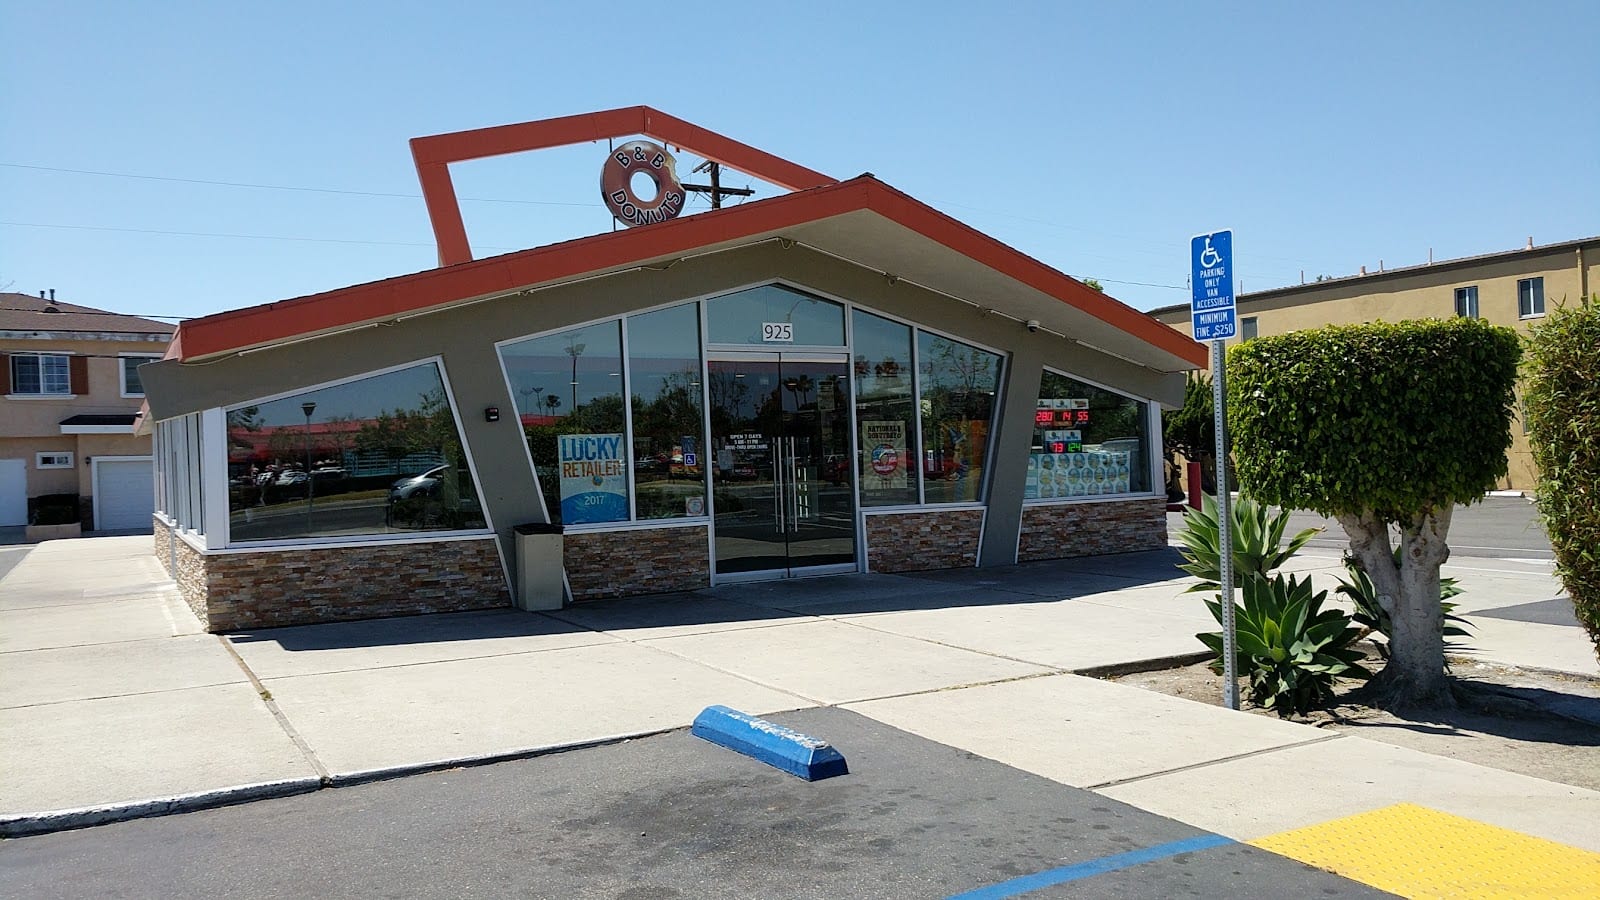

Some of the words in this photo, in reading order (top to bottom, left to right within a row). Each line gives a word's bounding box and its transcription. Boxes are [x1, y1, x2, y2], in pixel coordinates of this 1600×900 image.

[614, 152, 631, 168] B
[633, 146, 647, 161] &
[650, 152, 665, 169] B
[610, 188, 681, 225] DONUTS
[1200, 267, 1225, 279] PARKING
[1204, 278, 1220, 288] ONLY
[1206, 288, 1219, 297] VAN
[1196, 296, 1230, 309] ACCESSIBLE
[1200, 311, 1228, 325] MINIMUM
[764, 324, 791, 339] 925
[1196, 327, 1210, 338] FINE
[1214, 323, 1234, 335] $250
[1036, 411, 1053, 421] 280
[1062, 411, 1071, 421] 14
[1077, 411, 1089, 421] 55
[561, 436, 620, 462] LUCKY
[1067, 443, 1081, 452] 124
[563, 461, 622, 478] RETAILER
[584, 496, 604, 506] 2017
